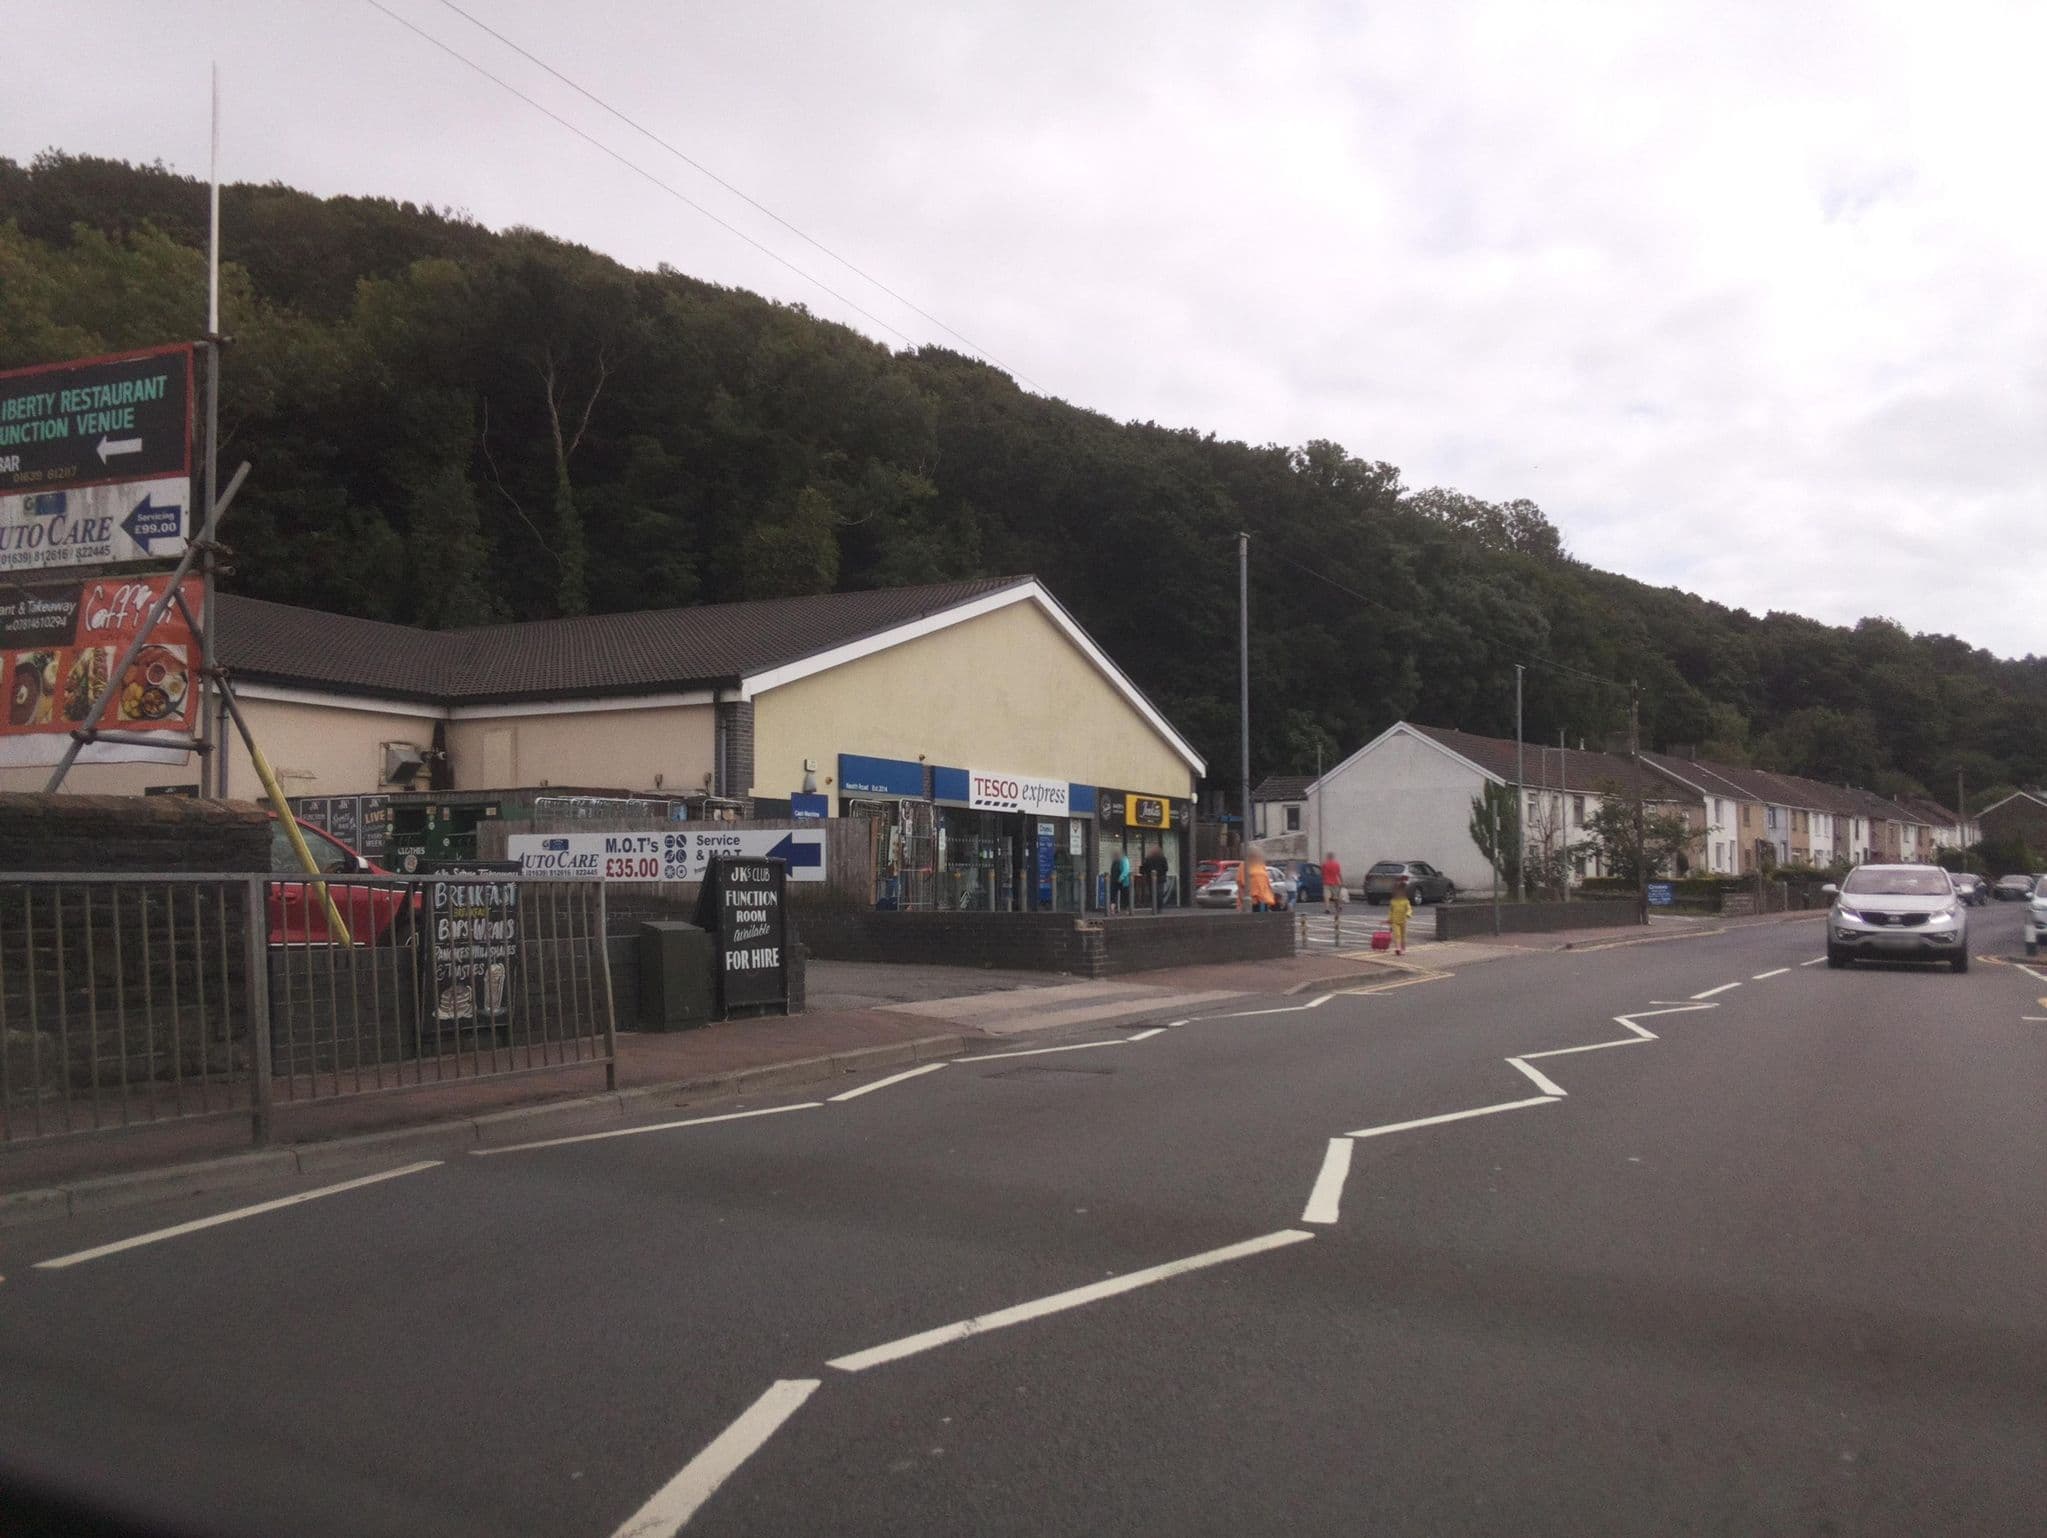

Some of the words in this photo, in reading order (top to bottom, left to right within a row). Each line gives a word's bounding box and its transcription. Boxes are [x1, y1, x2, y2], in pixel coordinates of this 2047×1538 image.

[61, 375, 167, 413] RESTAURANT
[77, 408, 135, 435] VENUE
[135, 522, 176, 534] £99.00
[974, 777, 1018, 799] TESCO
[1022, 784, 1065, 808] express
[605, 837, 659, 853] M.O.T's
[697, 835, 740, 846] Service
[696, 849, 704, 861] &
[606, 858, 659, 877] £35.00
[752, 868, 771, 881] CLUB
[725, 890, 778, 907] FUNCTION
[736, 910, 767, 923] ROOM
[725, 950, 750, 970] FOR
[751, 947, 780, 969] HIRE
